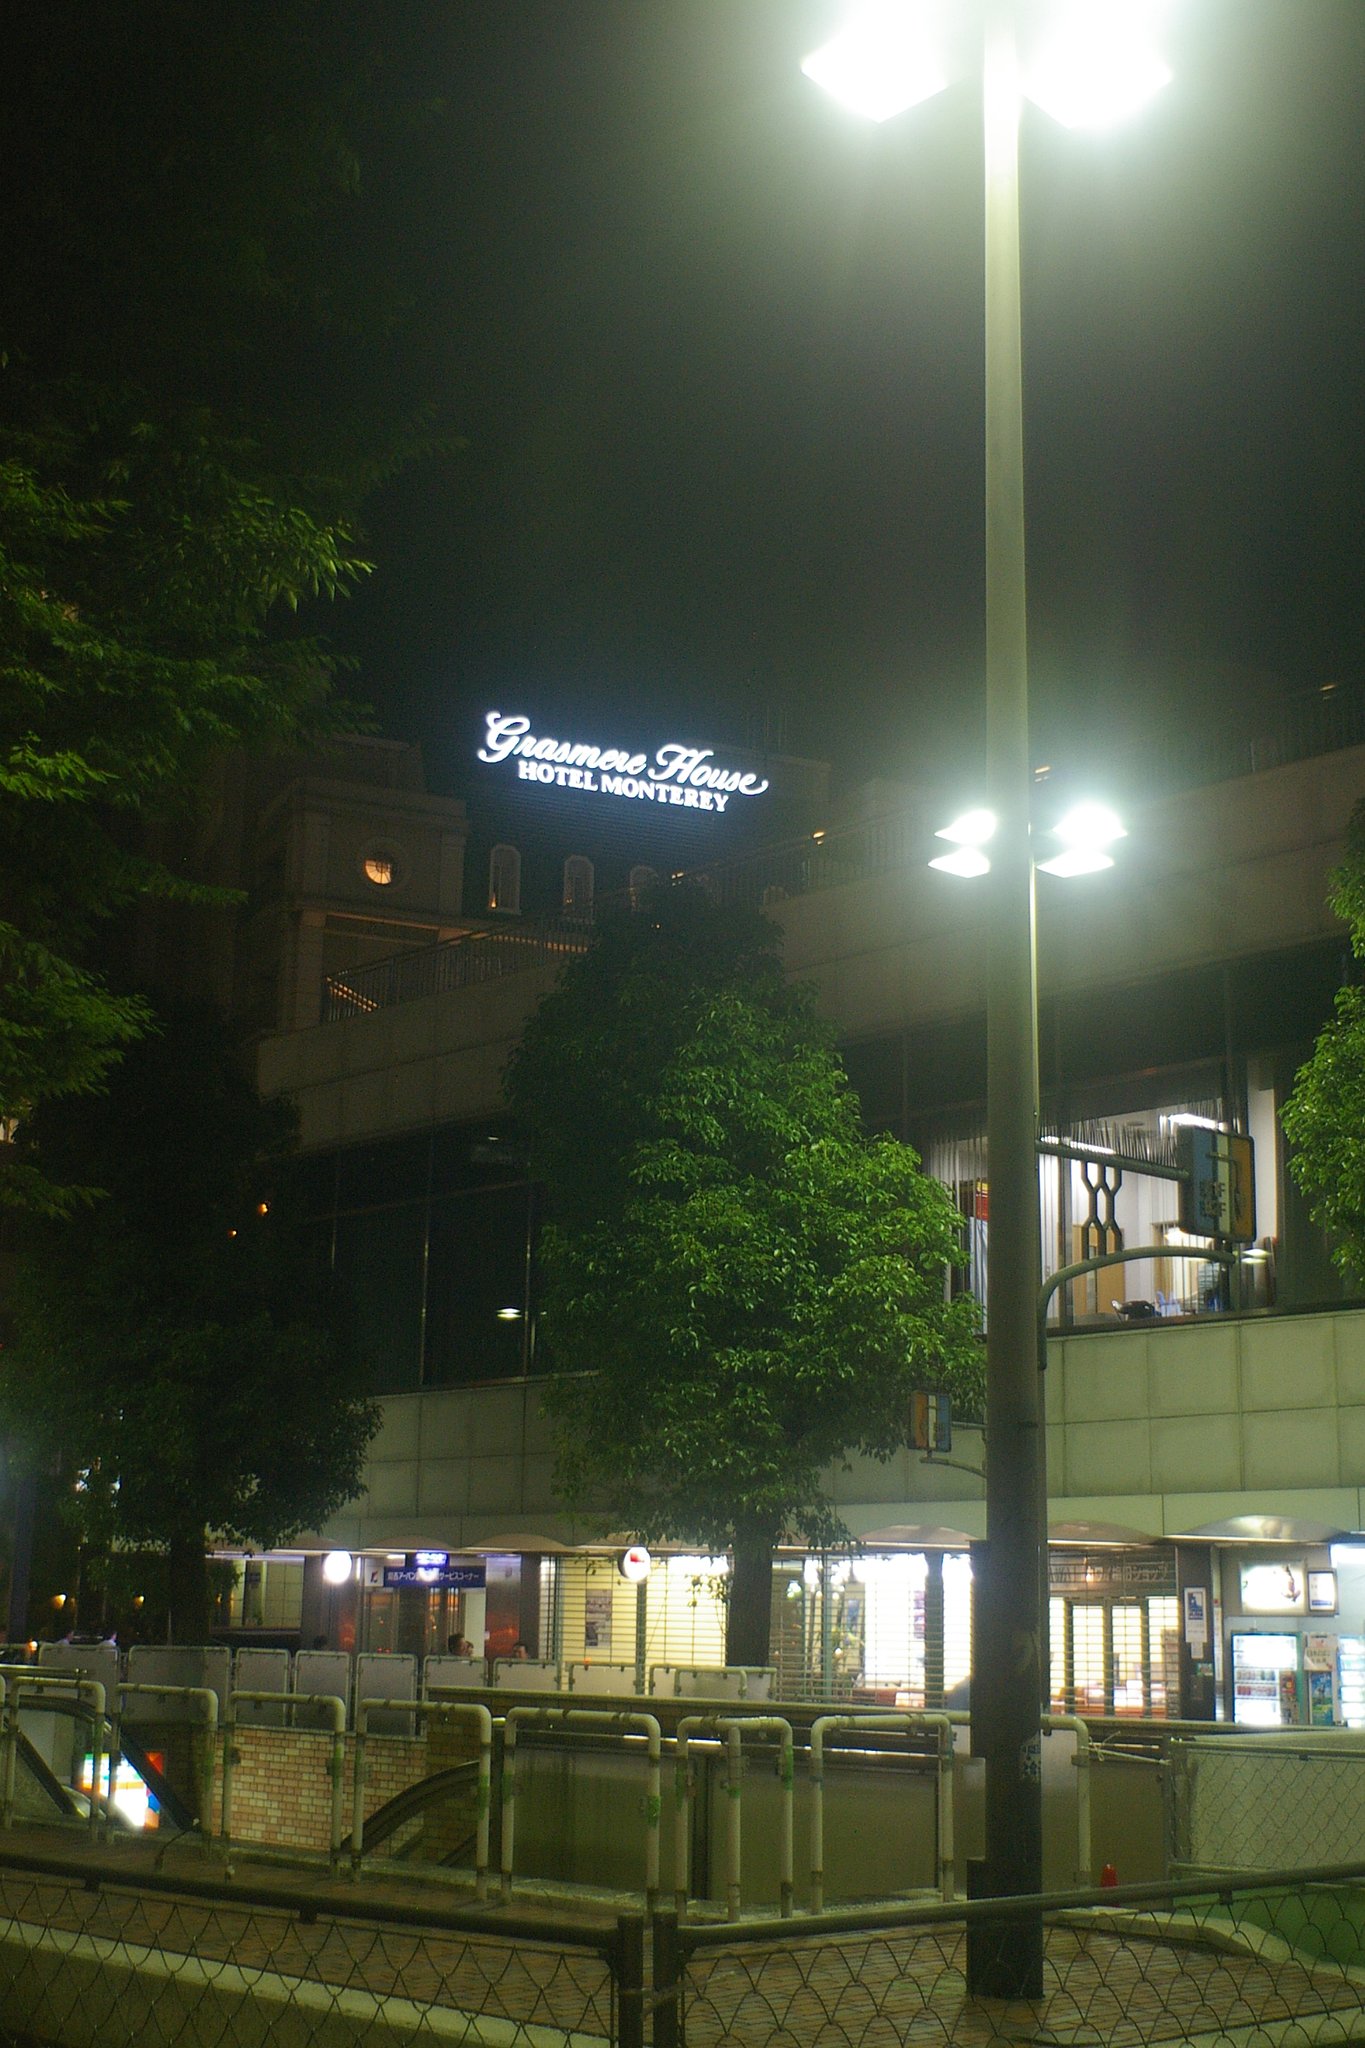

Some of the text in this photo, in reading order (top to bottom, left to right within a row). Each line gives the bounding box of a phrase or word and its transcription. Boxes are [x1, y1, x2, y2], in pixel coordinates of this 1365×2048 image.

[477, 710, 770, 796] Grasmere House
[518, 760, 730, 812] HOTEL MONTEREY
